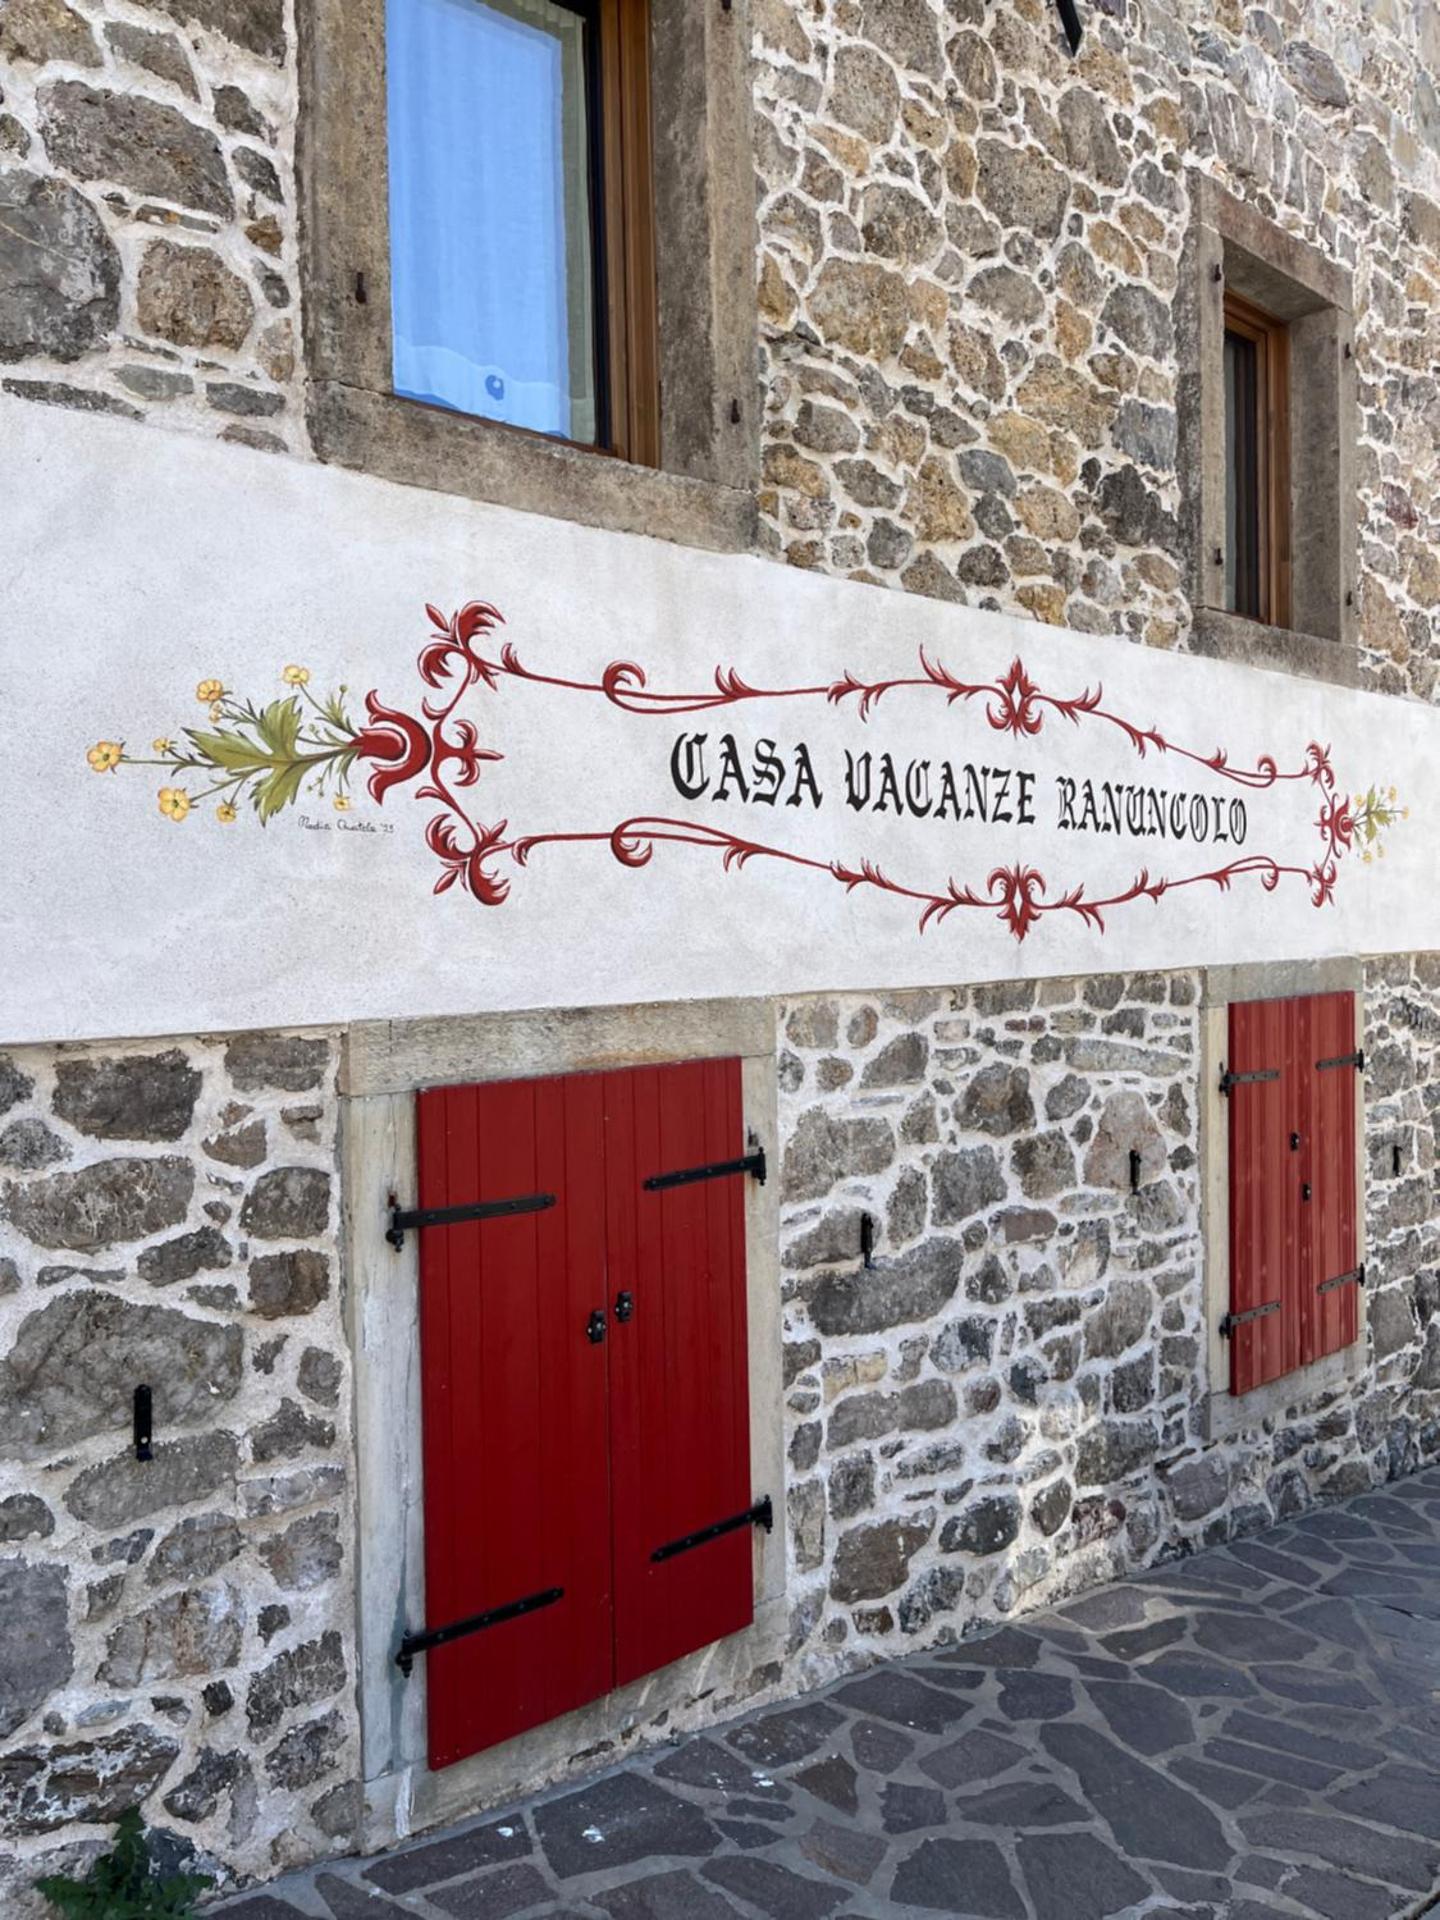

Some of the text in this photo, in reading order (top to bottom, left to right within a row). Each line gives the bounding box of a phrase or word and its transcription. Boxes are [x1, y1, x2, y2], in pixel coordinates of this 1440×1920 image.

[670, 732, 1247, 845] CASA VACANZE RANUNCOLO
